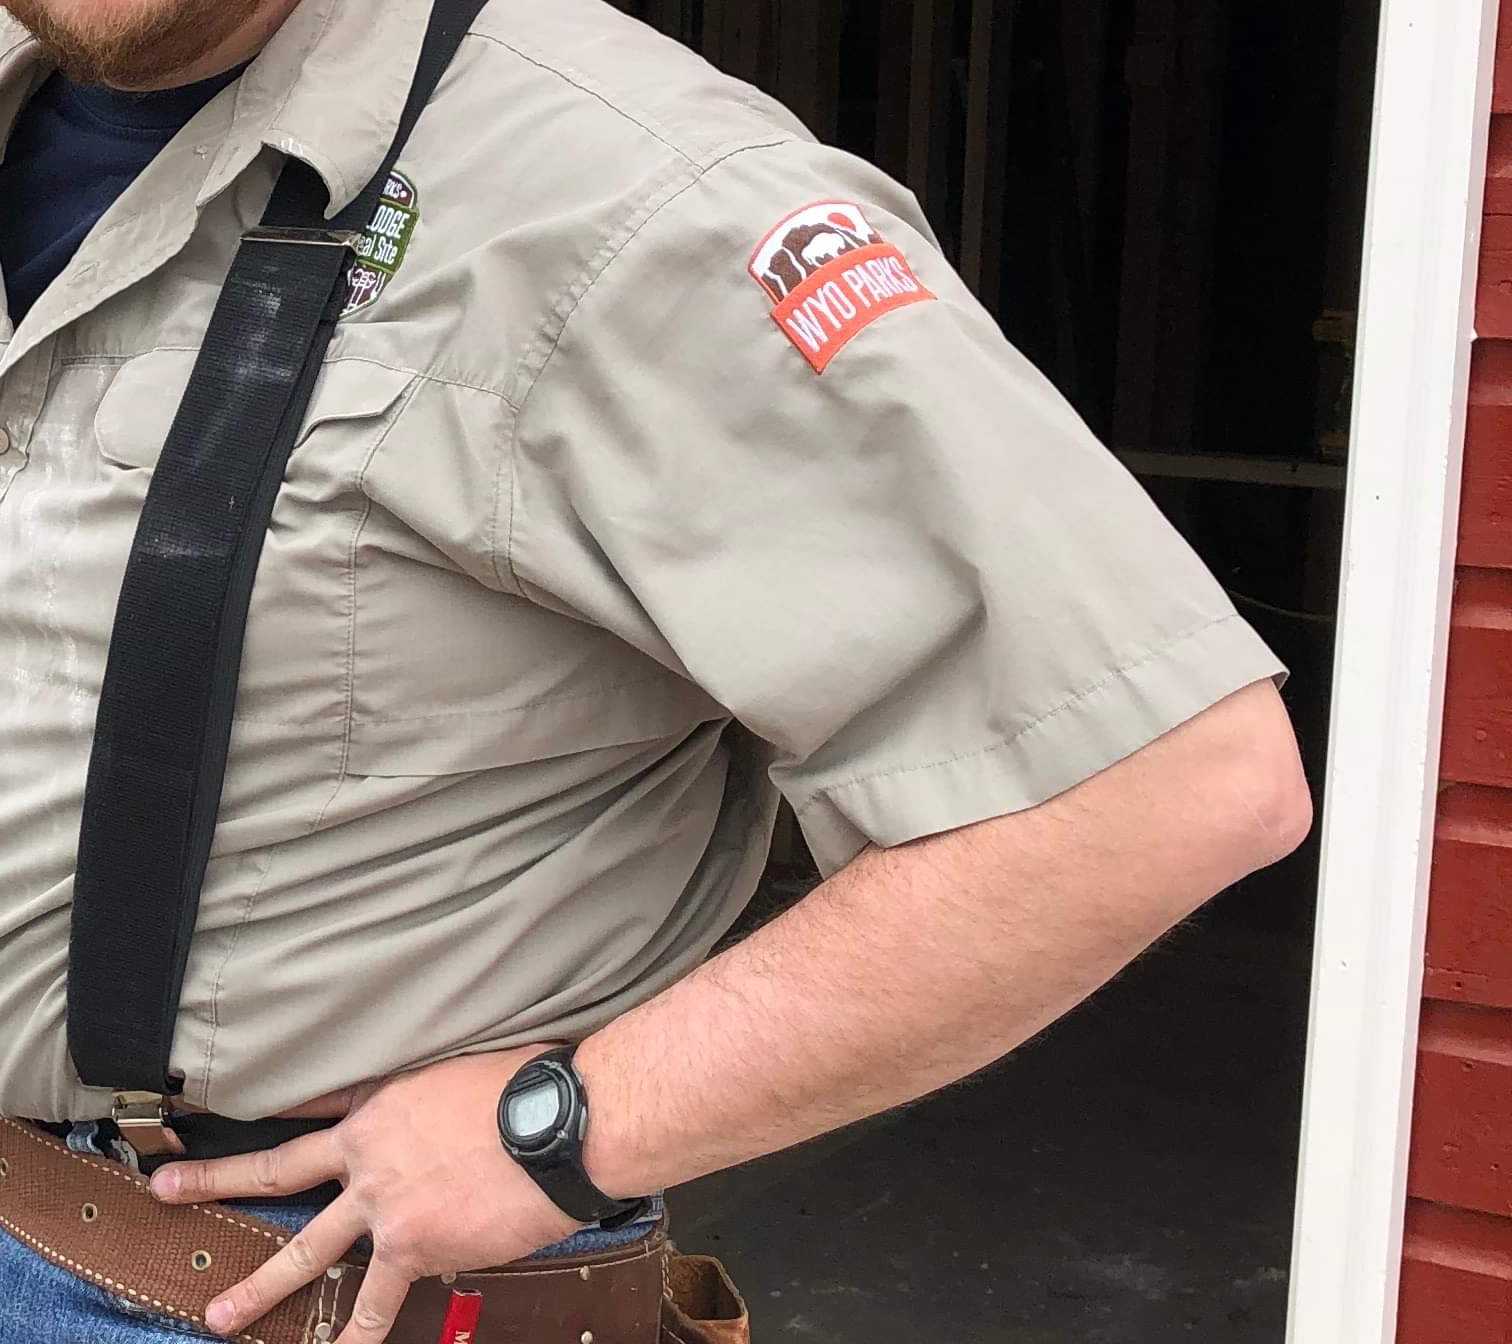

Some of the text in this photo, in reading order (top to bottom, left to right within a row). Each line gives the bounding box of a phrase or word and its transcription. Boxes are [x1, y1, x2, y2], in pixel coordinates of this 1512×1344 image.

[366, 205, 410, 238] ODGE
[786, 255, 920, 352] WYO PARKS
